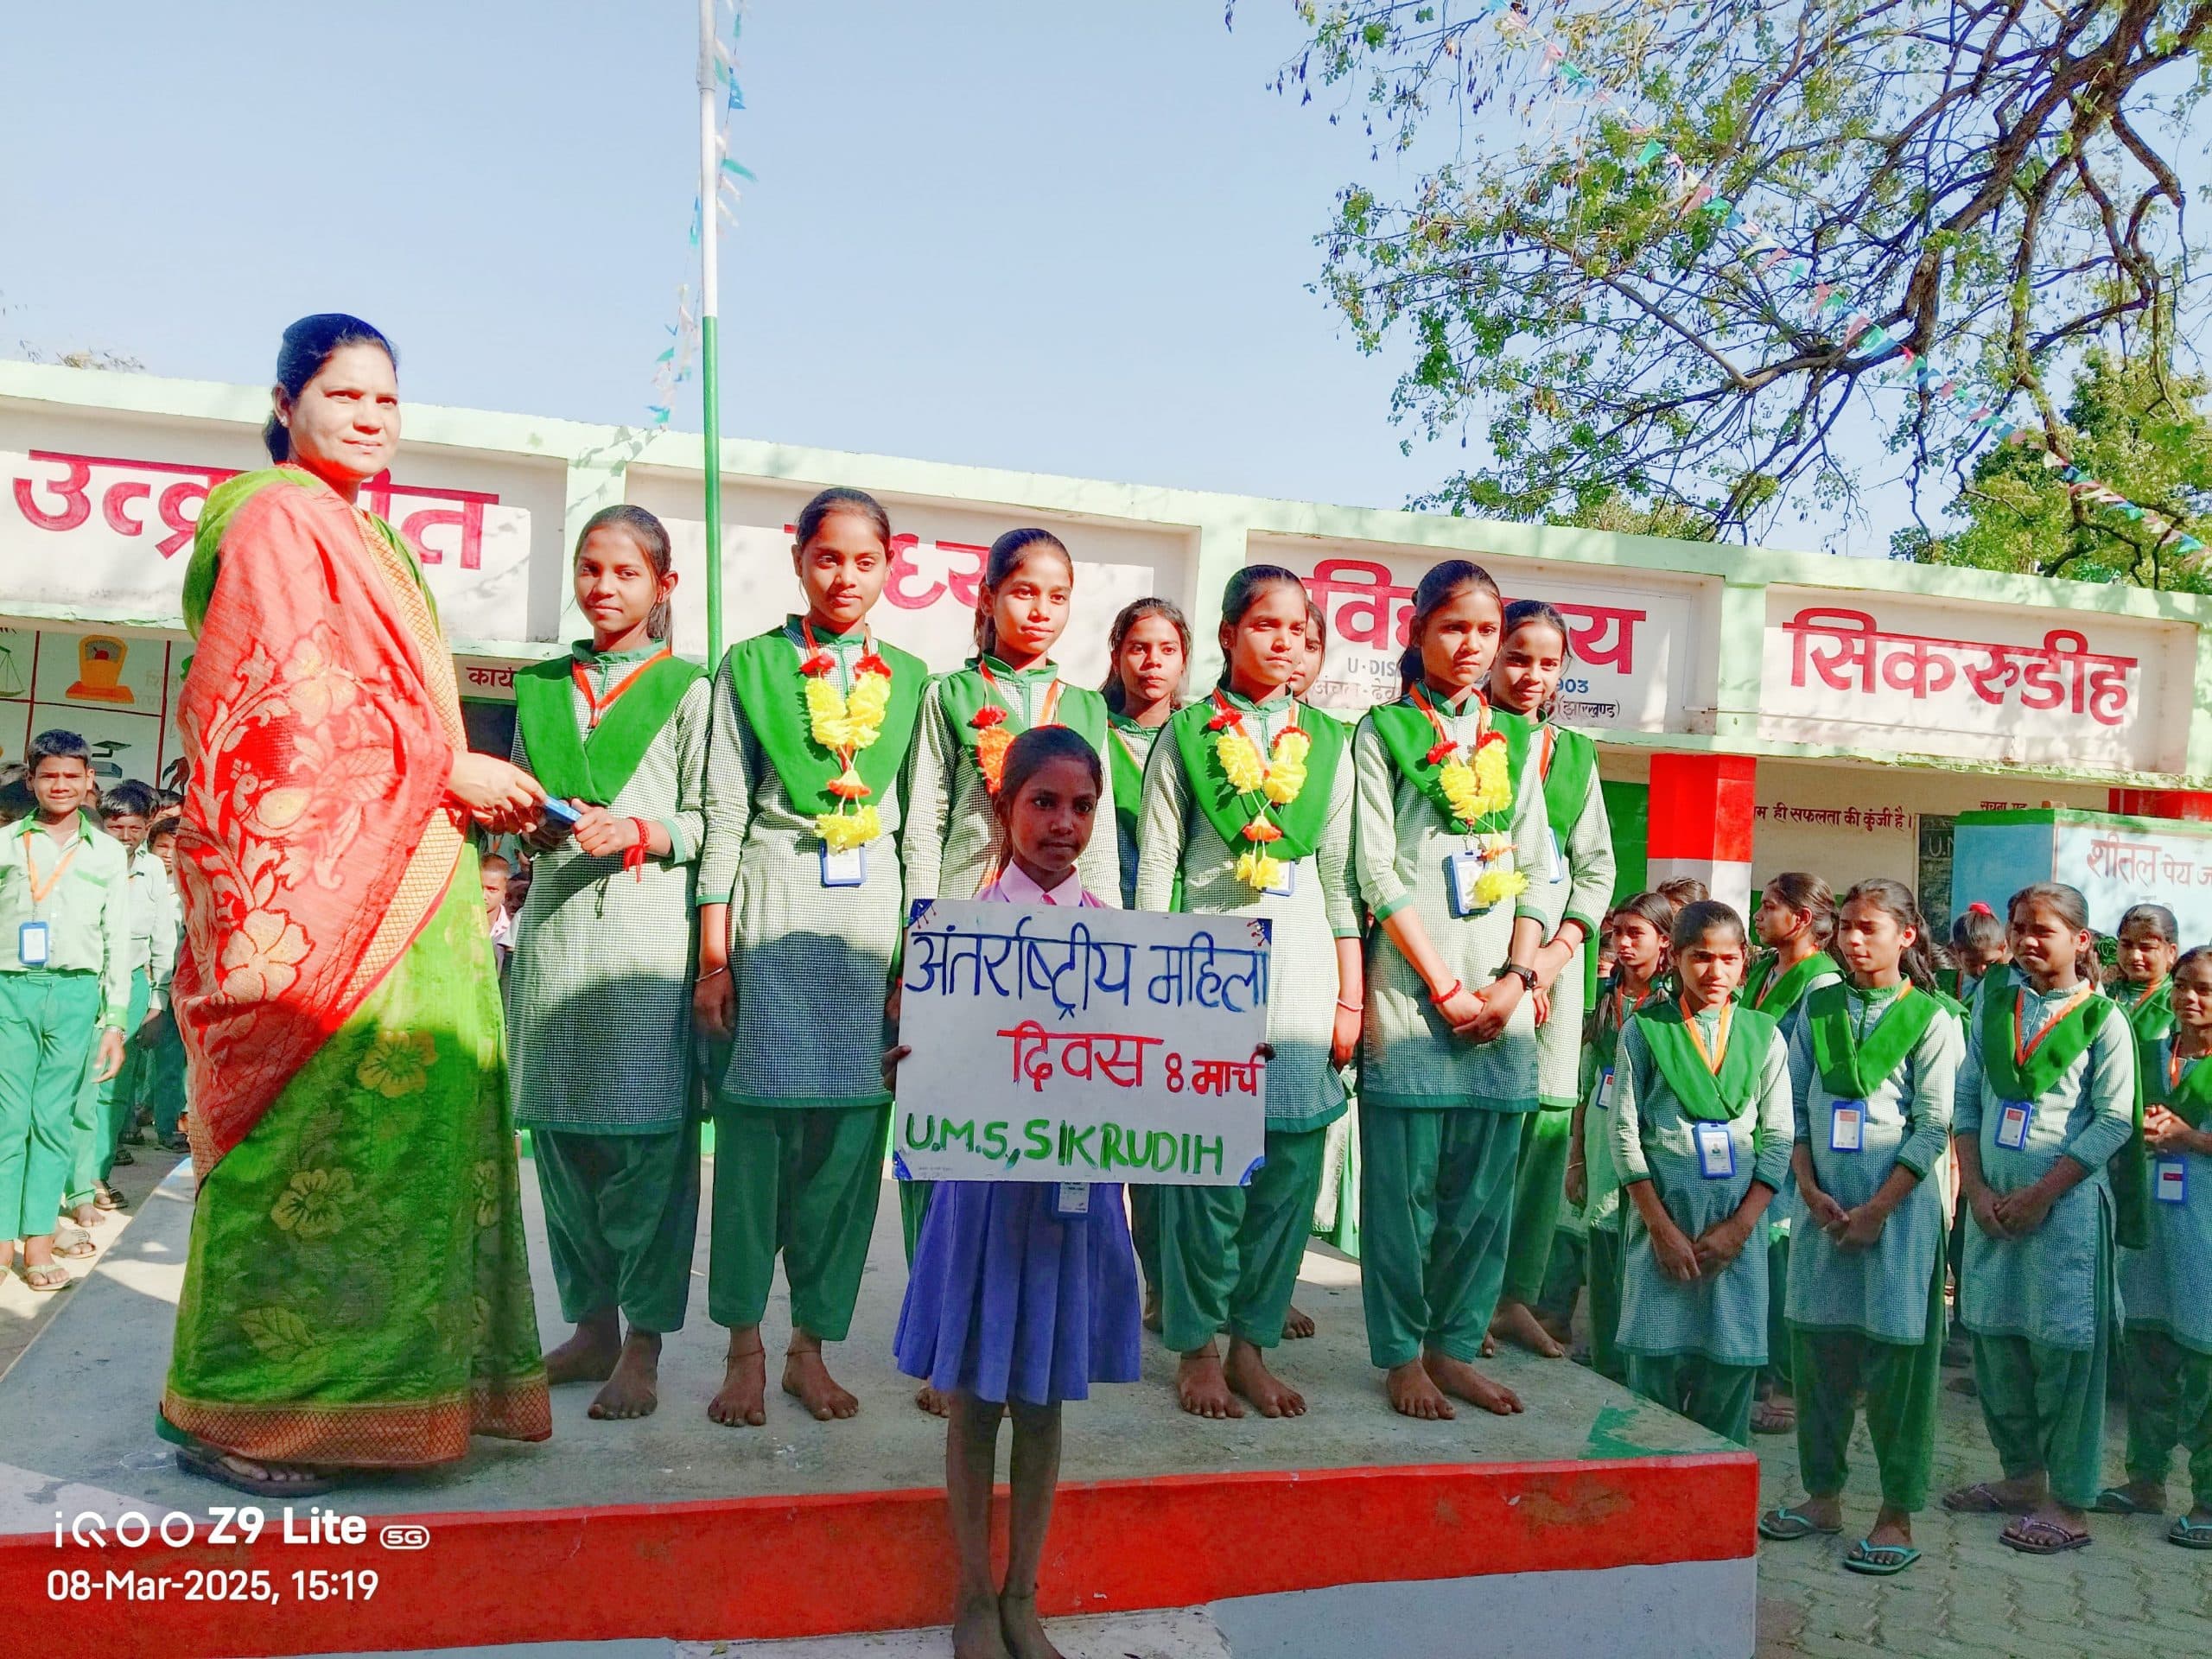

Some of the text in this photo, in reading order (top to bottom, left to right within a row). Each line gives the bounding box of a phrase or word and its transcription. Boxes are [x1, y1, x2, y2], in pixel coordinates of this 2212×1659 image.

[1556, 677, 1589, 694] 903
[1783, 607, 2138, 725] सिकरुडीह
[1773, 802, 1788, 823] ही
[1790, 807, 1841, 828] सफलता
[1844, 805, 1861, 828] की
[1864, 806, 1893, 832] कुंजी
[2087, 831, 2212, 888] शीतल पेय ज
[905, 916, 1270, 1020] अंतर्राष्ट्रीय महिला
[996, 1020, 1165, 1093] दिवस
[1192, 1051, 1266, 1097] मार्च
